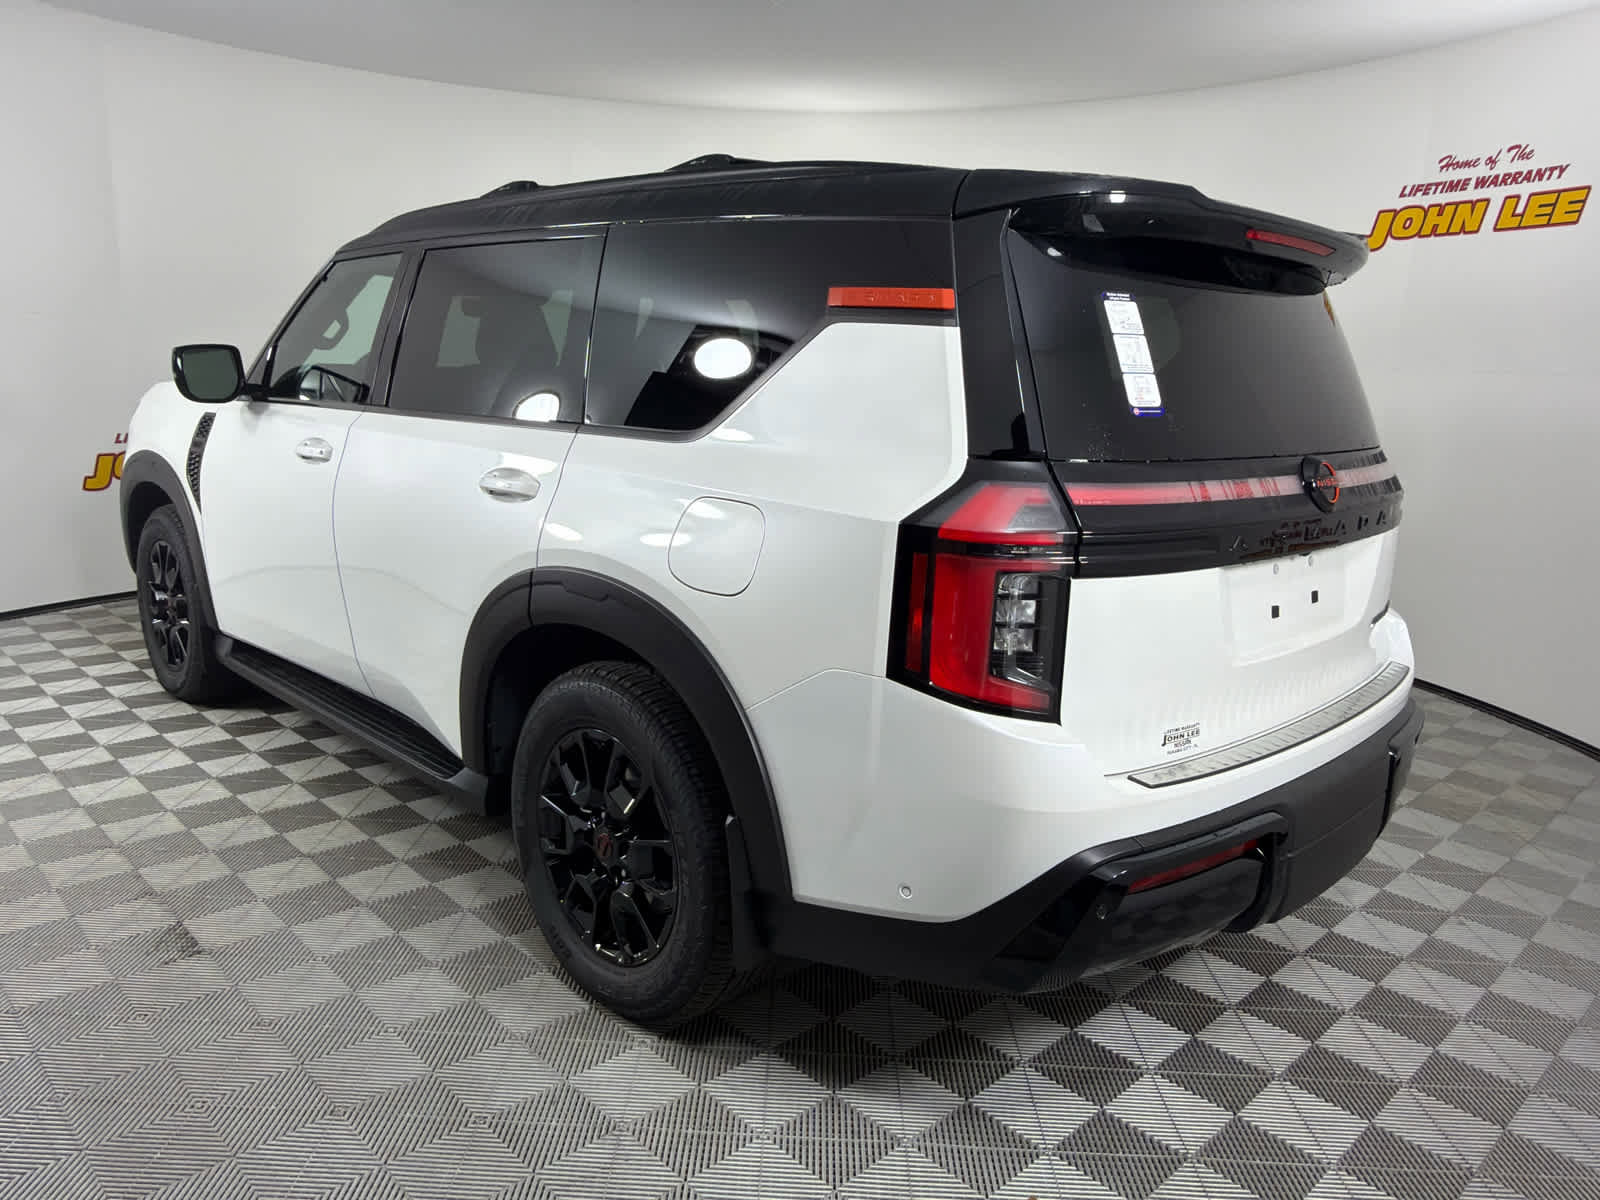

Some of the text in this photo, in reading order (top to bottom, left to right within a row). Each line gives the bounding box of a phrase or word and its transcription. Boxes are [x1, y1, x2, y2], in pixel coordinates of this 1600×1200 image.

[1438, 144, 1535, 173] Home of The
[1398, 164, 1570, 199] LIFETIME WARRANTY
[1367, 185, 1593, 252] JOHN LEE
[1161, 729, 1200, 746] JOHN LEE
